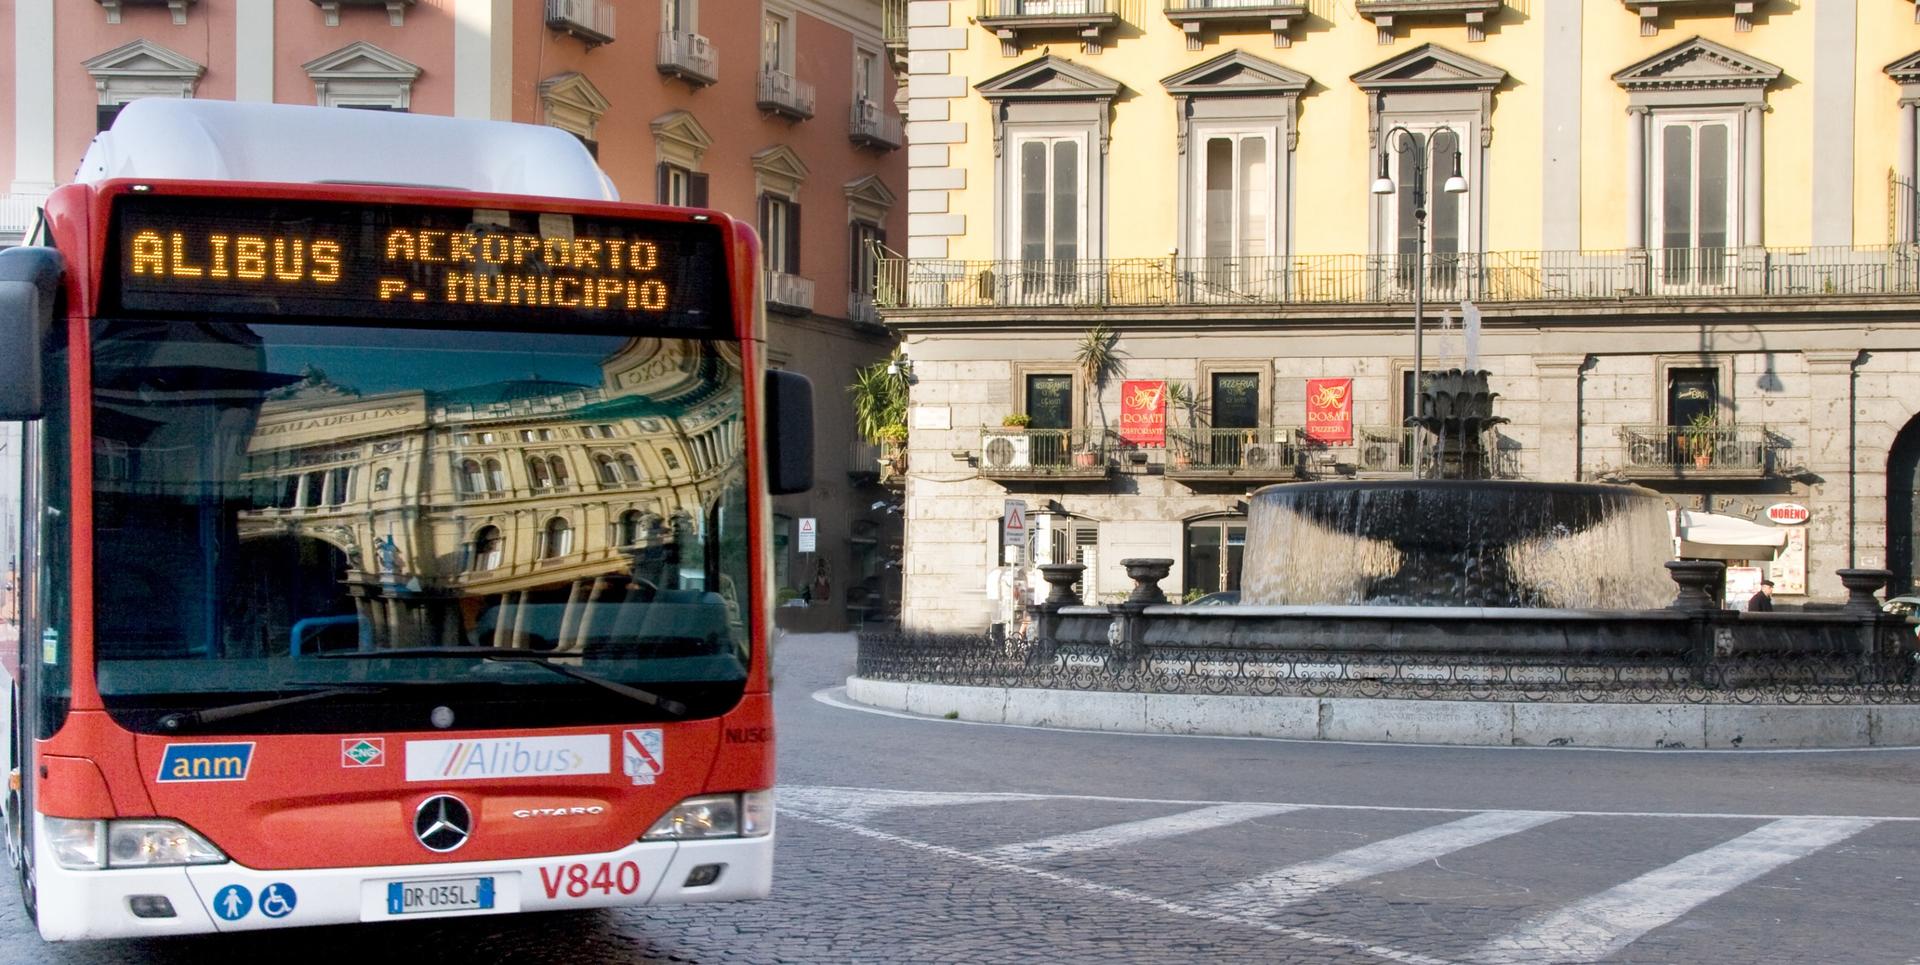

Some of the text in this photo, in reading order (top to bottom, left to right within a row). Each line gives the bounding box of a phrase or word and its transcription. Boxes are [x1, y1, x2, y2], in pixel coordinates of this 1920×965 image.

[133, 231, 340, 282] ALIBUS
[387, 229, 657, 271] AEROPORTO
[447, 272, 667, 310] MUNICIPIO
[1123, 413, 1163, 424] ROSATI
[1309, 411, 1349, 421] ROSATI
[1770, 508, 1807, 520] MORENO
[350, 748, 376, 758] CNG
[461, 741, 572, 776] Alibus
[172, 756, 243, 778] anm
[512, 805, 604, 820] CITARO
[539, 860, 642, 900] V840
